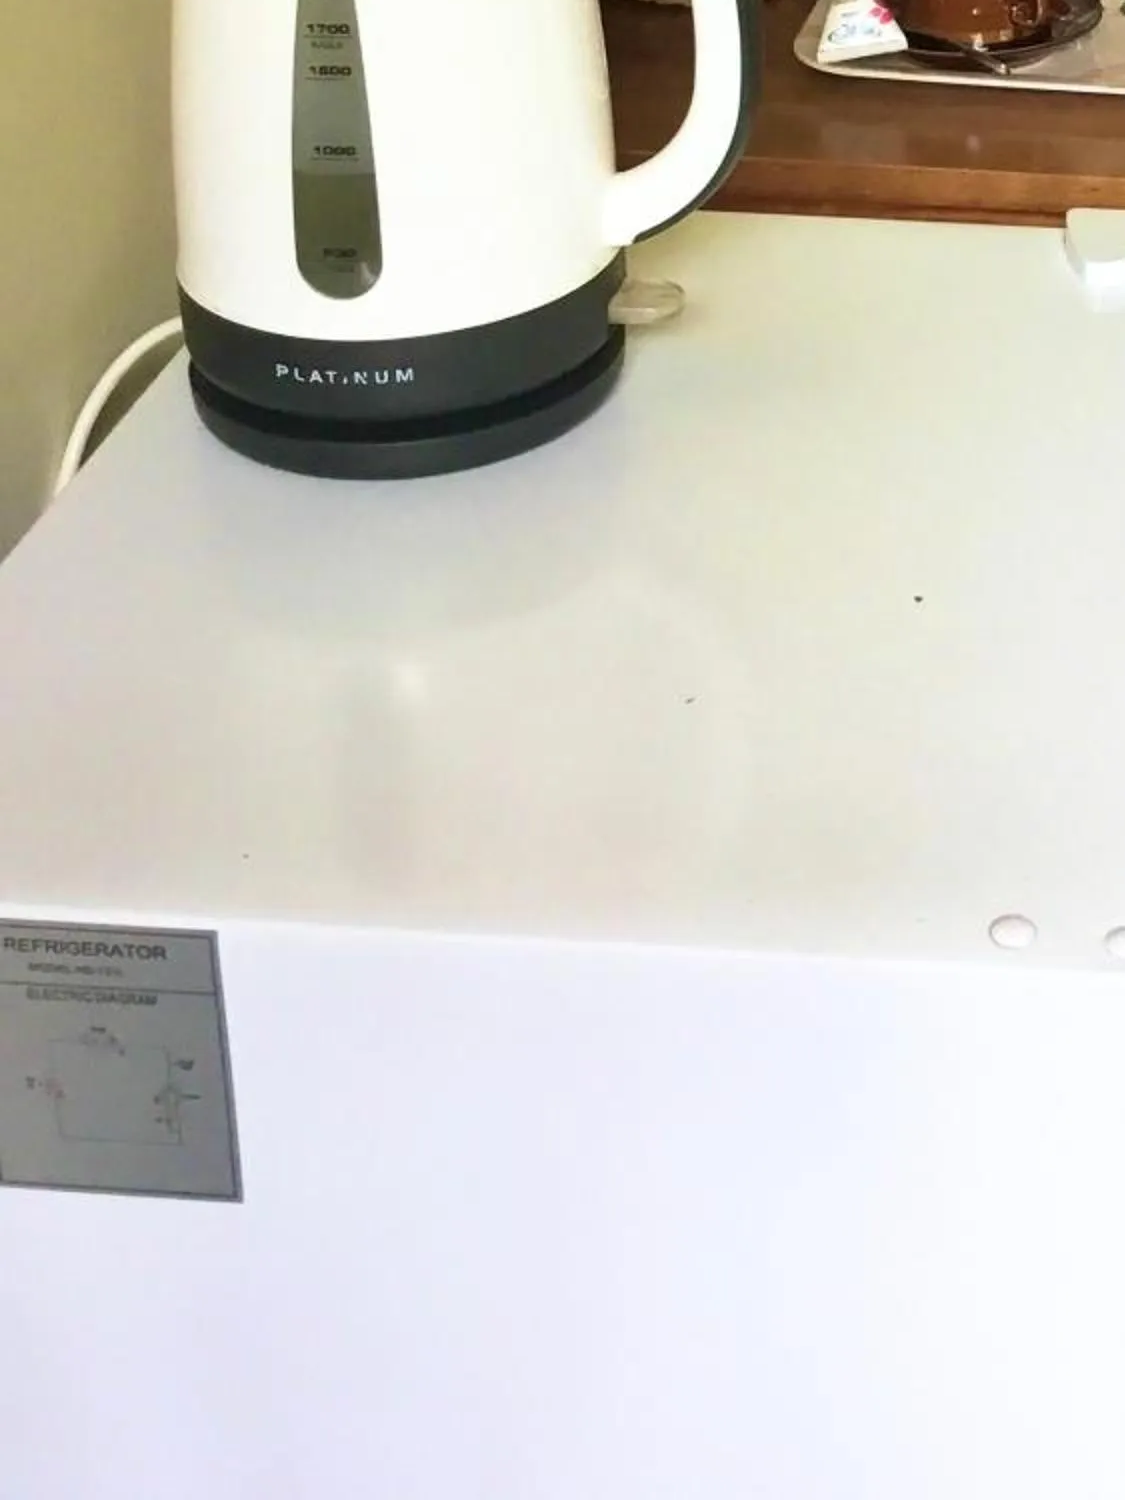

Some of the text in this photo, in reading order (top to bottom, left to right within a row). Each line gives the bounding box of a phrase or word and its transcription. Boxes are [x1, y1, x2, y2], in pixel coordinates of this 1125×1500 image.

[306, 23, 350, 34] 1700
[275, 362, 415, 385] PLATINUM
[4, 937, 167, 960] REFRIGERATOR
